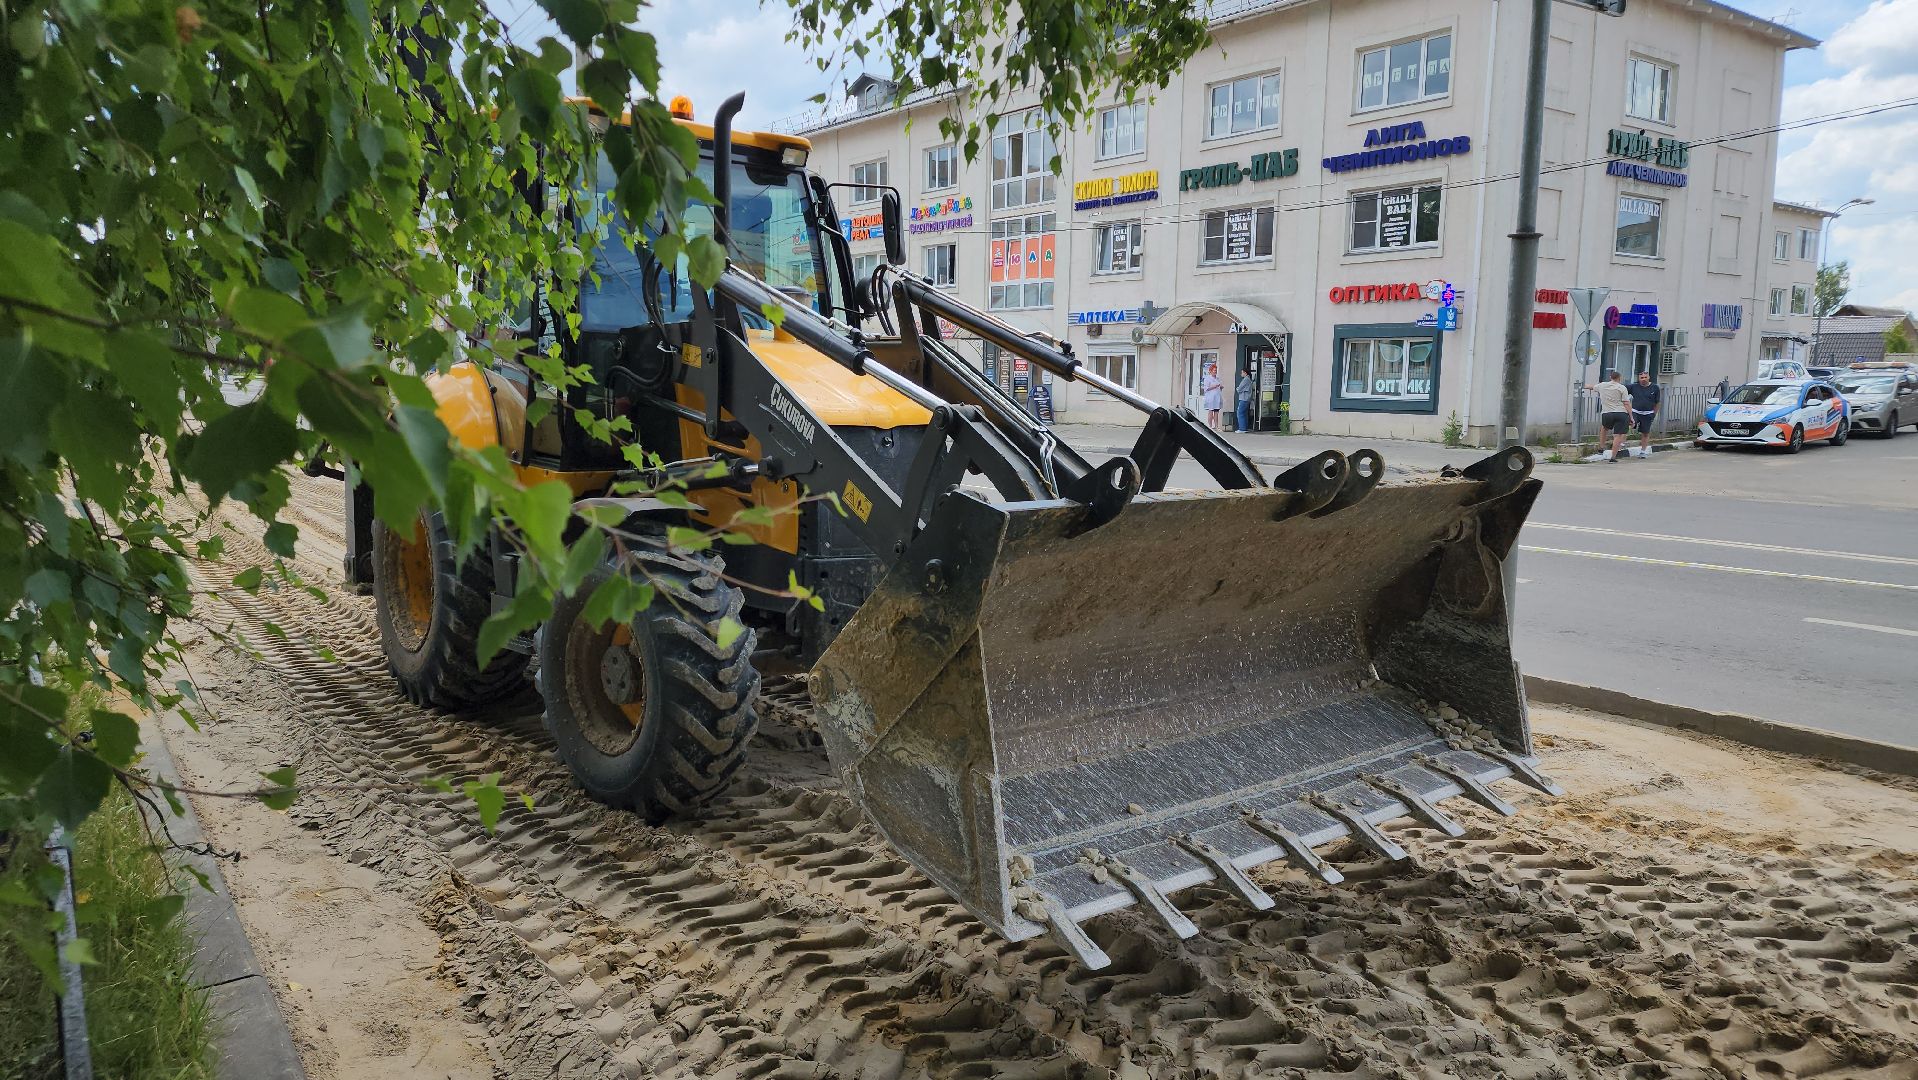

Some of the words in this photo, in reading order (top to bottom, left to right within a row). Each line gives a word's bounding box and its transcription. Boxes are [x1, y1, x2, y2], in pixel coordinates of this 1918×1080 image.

[1364, 121, 1426, 147] ЛИГА
[1322, 136, 1471, 173] ЧЕМПИОНОВ
[1179, 148, 1299, 191] ГРИЛЬ-ПАБ
[1607, 161, 1635, 179] ЛИГА
[1618, 198, 1660, 217] RILL&BAR
[851, 212, 884, 228] АВТОШК
[1329, 282, 1421, 305] ОПТИКА
[1078, 309, 1126, 324] АПТЕКА
